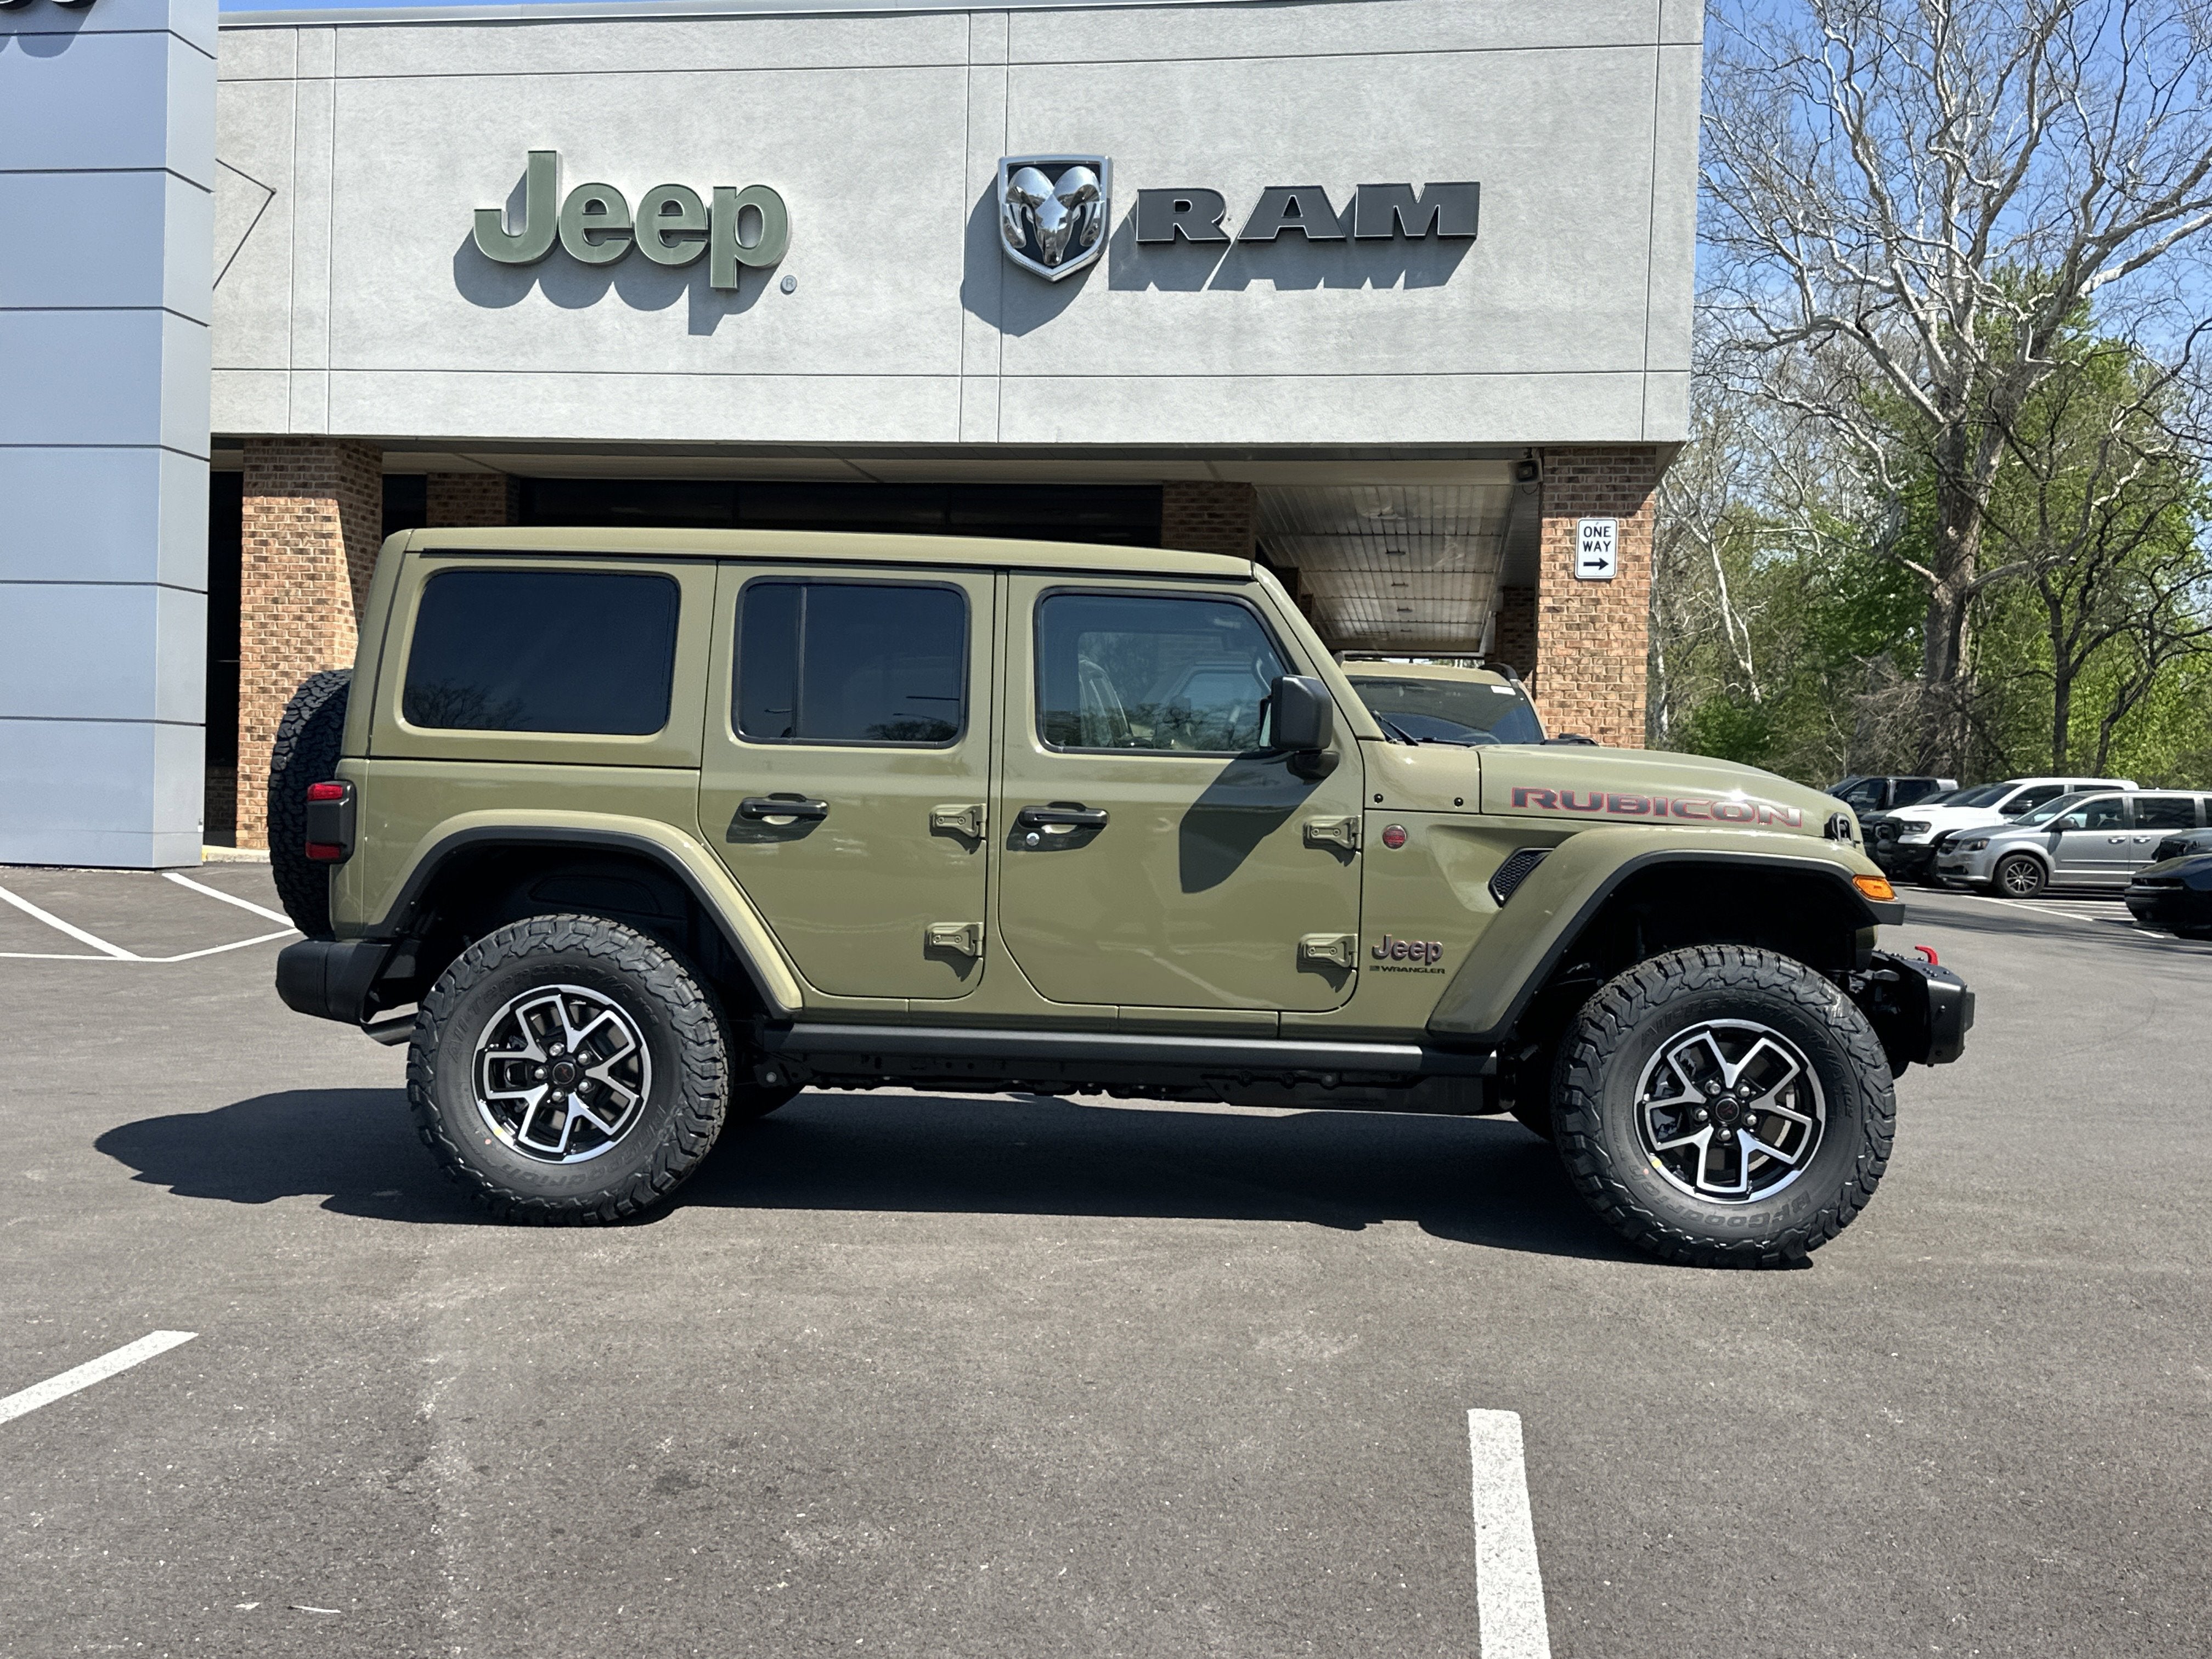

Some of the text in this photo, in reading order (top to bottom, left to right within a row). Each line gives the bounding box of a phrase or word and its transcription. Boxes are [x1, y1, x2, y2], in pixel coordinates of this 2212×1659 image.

[473, 150, 791, 290] Jeep
[1136, 182, 1480, 242] RAM
[1583, 526, 1611, 537] ONE
[1583, 540, 1611, 552] WAY
[1511, 787, 1802, 828] RUBICON
[1372, 934, 1443, 964] Jeep
[1381, 966, 1446, 974] WRANGLER
